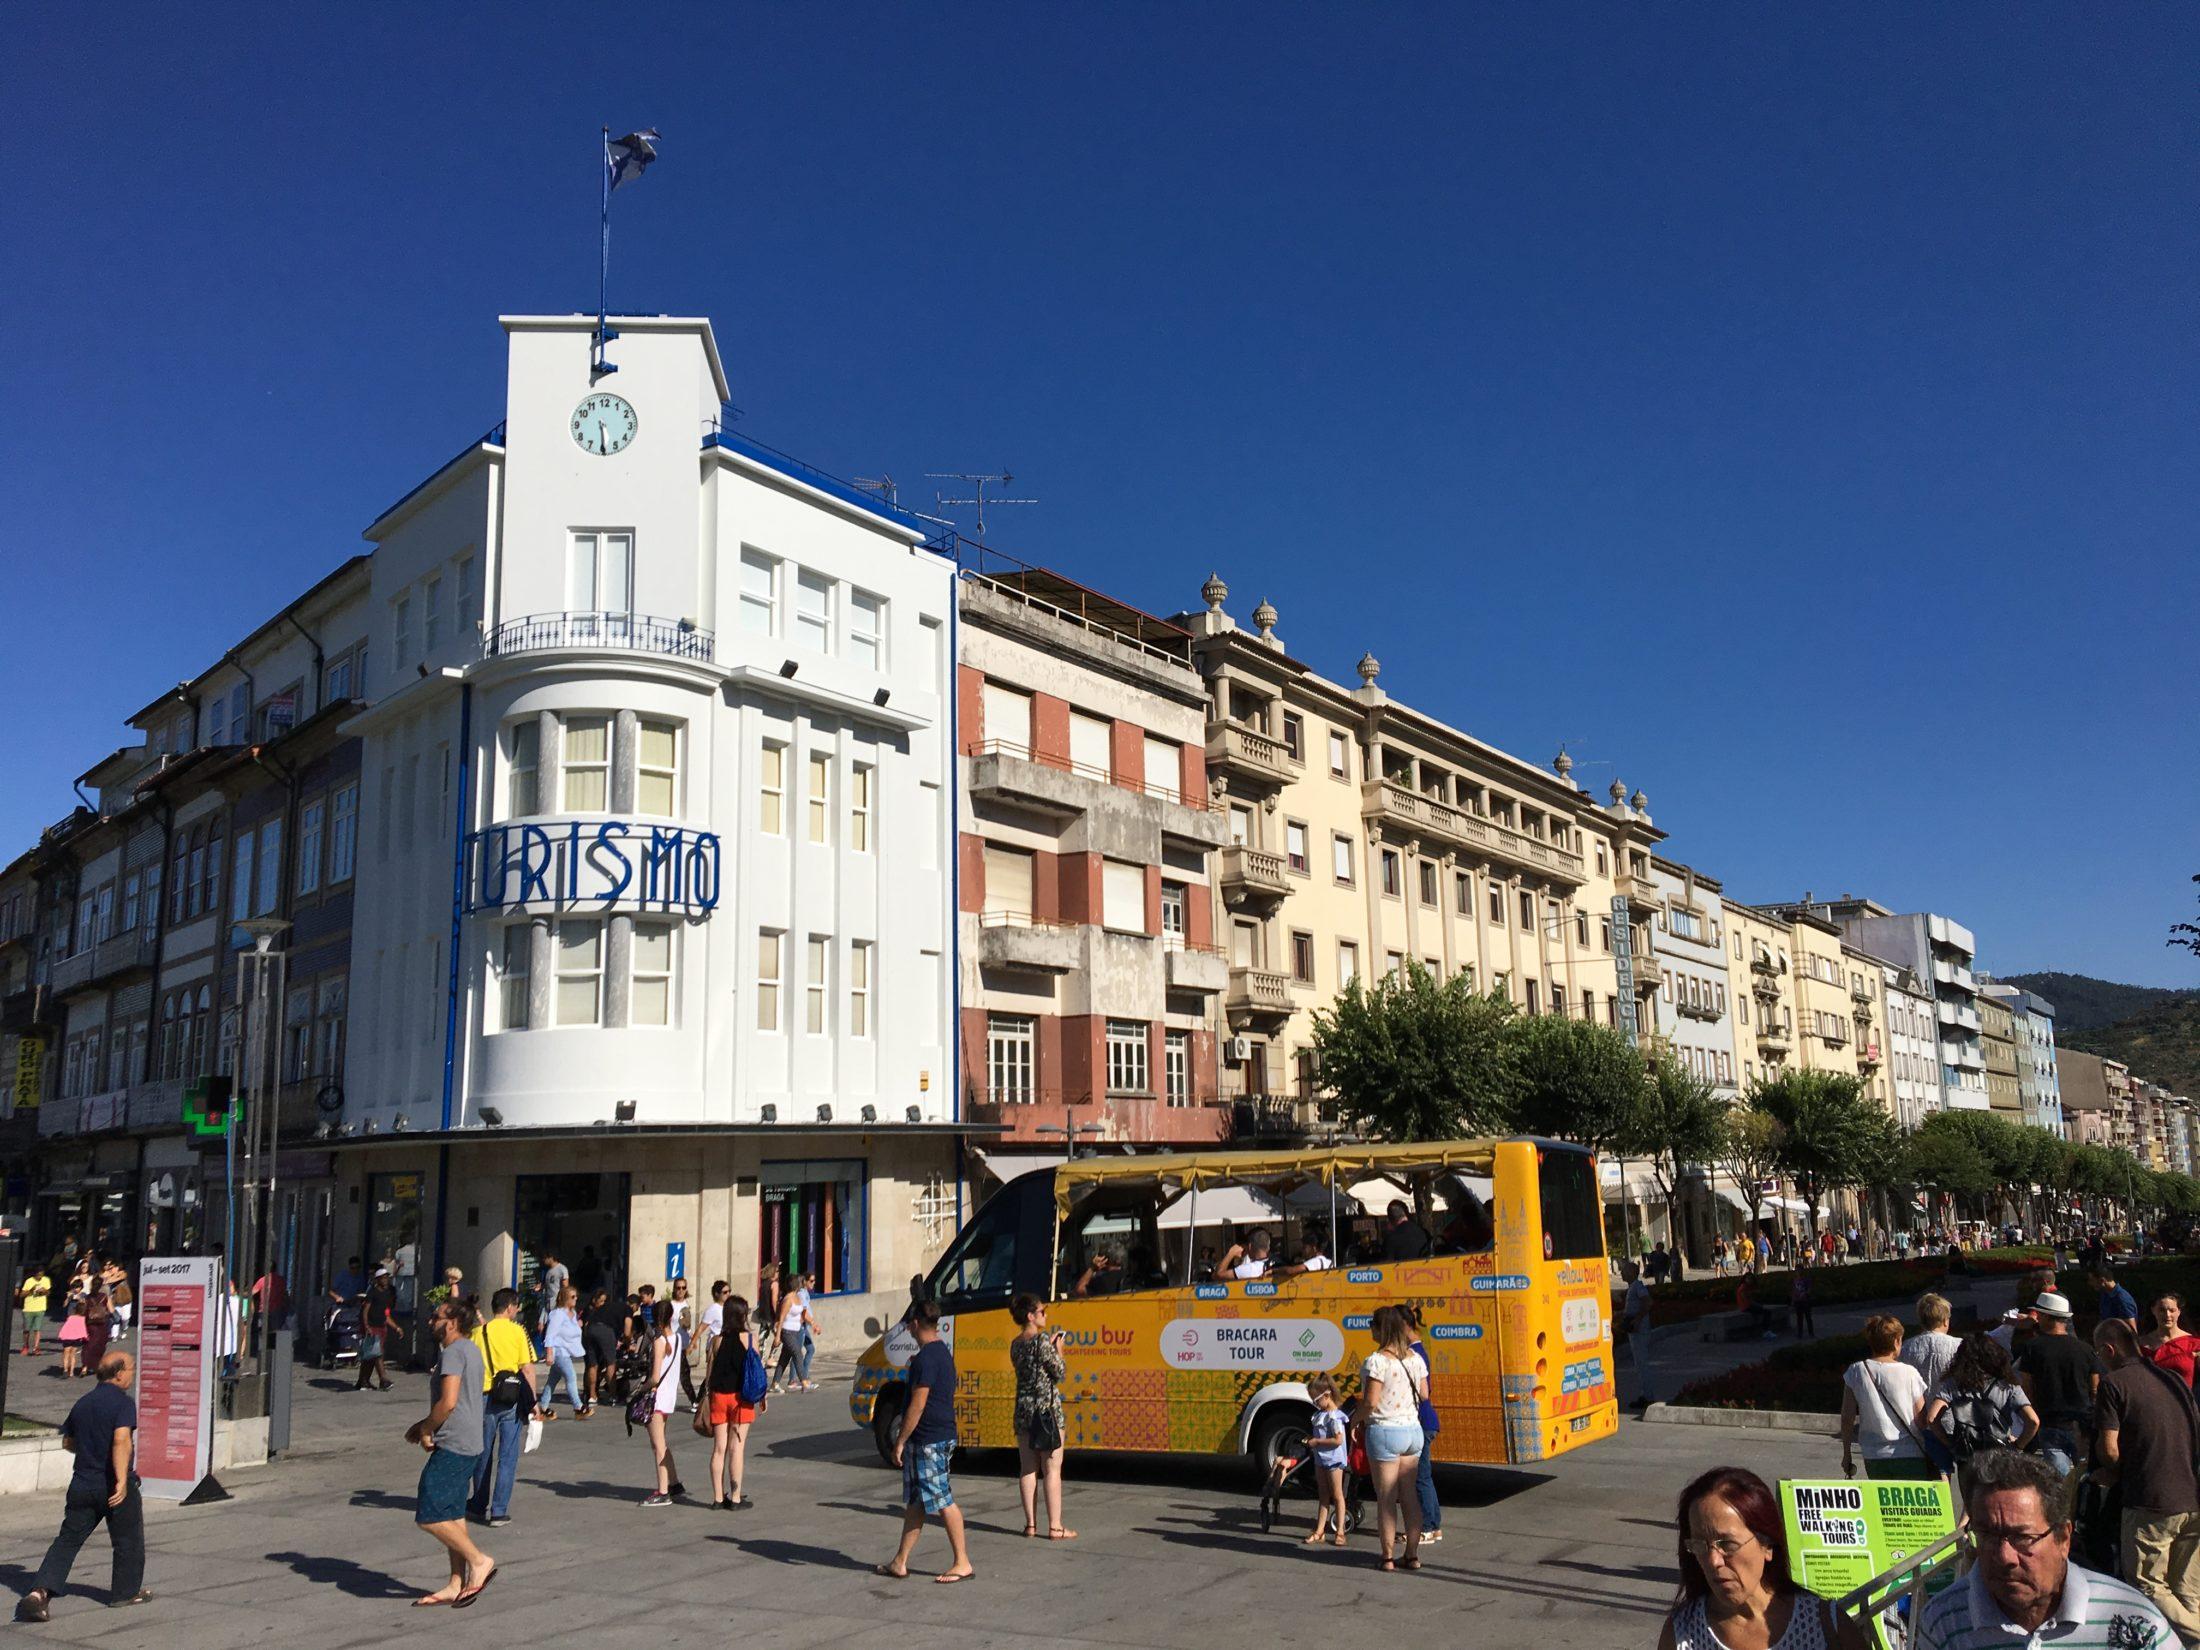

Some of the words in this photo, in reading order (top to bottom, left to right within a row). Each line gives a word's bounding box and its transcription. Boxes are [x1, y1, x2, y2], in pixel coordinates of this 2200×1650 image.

[587, 402, 595, 410] 11
[600, 399, 610, 407] 12
[615, 402, 619, 411] 1
[579, 409, 588, 418] 10
[624, 410, 629, 418] 2
[574, 421, 580, 429] 9
[627, 422, 633, 430] 3
[578, 432, 583, 441] 8
[622, 433, 628, 441] 4
[587, 440, 593, 449] 7
[613, 441, 618, 449] 5
[464, 821, 721, 916] TURISMO
[171, 1264, 191, 1274] 2017
[1350, 1272, 1379, 1281] PORTO
[1472, 1276, 1528, 1290] GUIMARÃES
[1199, 1287, 1227, 1298] BRAGA
[1247, 1282, 1276, 1295] LISBOA
[1347, 1318, 1371, 1327] FUNC
[1216, 1328, 1277, 1342] BRACARA
[1435, 1327, 1478, 1337] COIMBRA
[1177, 1352, 1195, 1362] HOP
[1229, 1347, 1265, 1360] TOUR
[1877, 1487, 1940, 1507] BRAGA
[1798, 1509, 1821, 1520] FREE
[1880, 1507, 1909, 1516] VISITAS
[1910, 1507, 1943, 1516] GUIADAS
[1800, 1520, 1854, 1532] WALKING
[1822, 1533, 1856, 1545] TOURS
